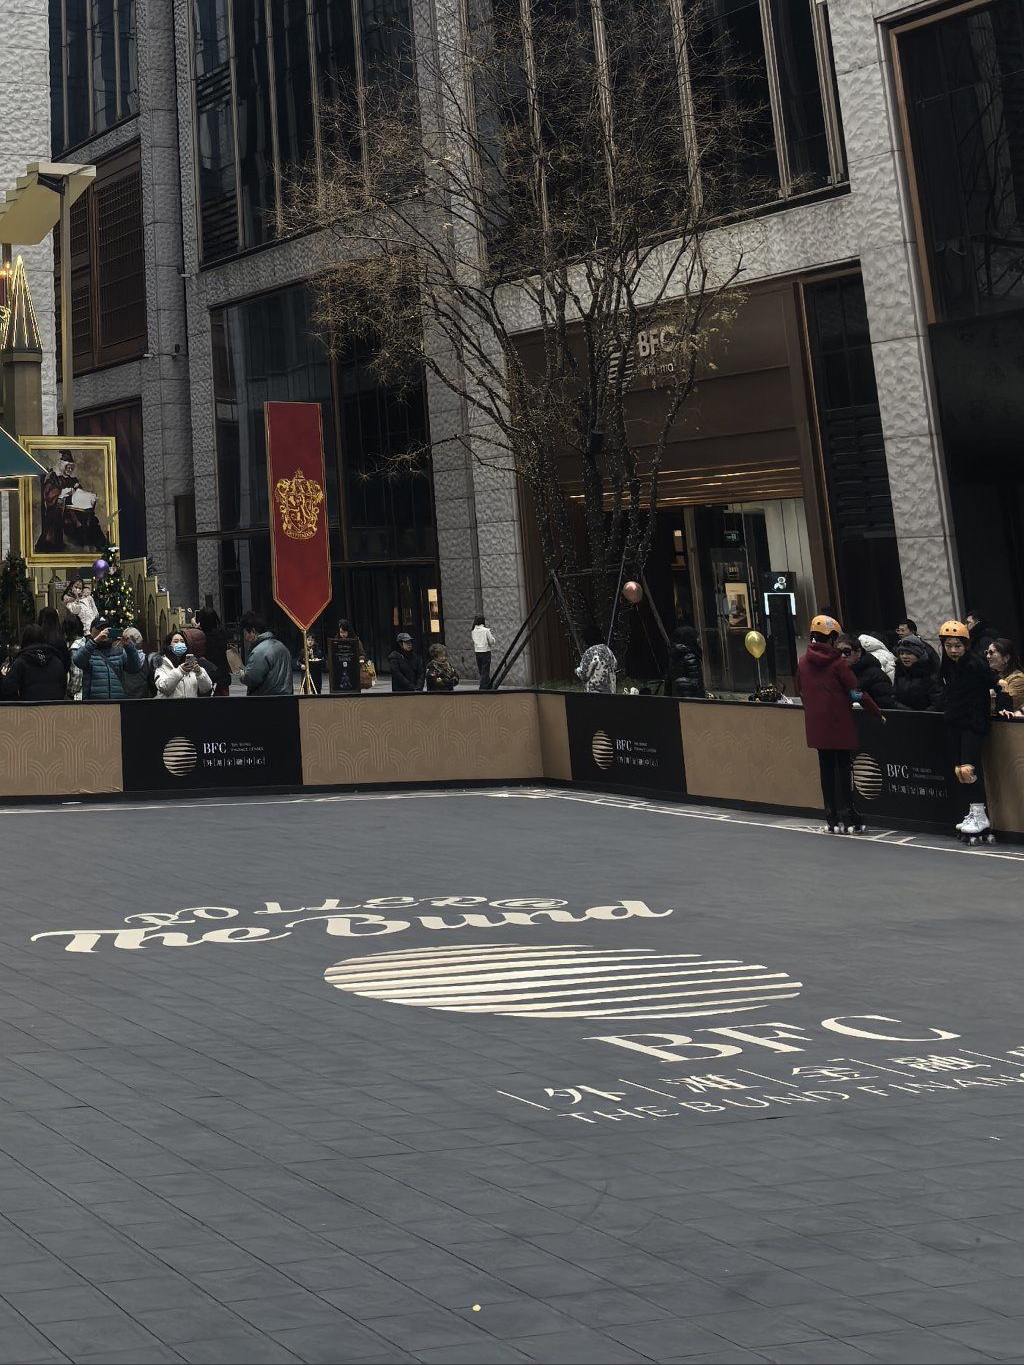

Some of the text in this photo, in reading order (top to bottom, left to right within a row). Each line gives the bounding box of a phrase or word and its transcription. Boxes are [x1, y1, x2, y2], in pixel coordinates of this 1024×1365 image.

[637, 326, 676, 356] BFC
[203, 742, 227, 754] BFC
[616, 739, 632, 751] BFC
[887, 763, 909, 779] BFC
[30, 900, 674, 953] The Bund
[582, 1015, 962, 1063] BFC
[557, 1072, 1024, 1123] THE BUND FINAN
